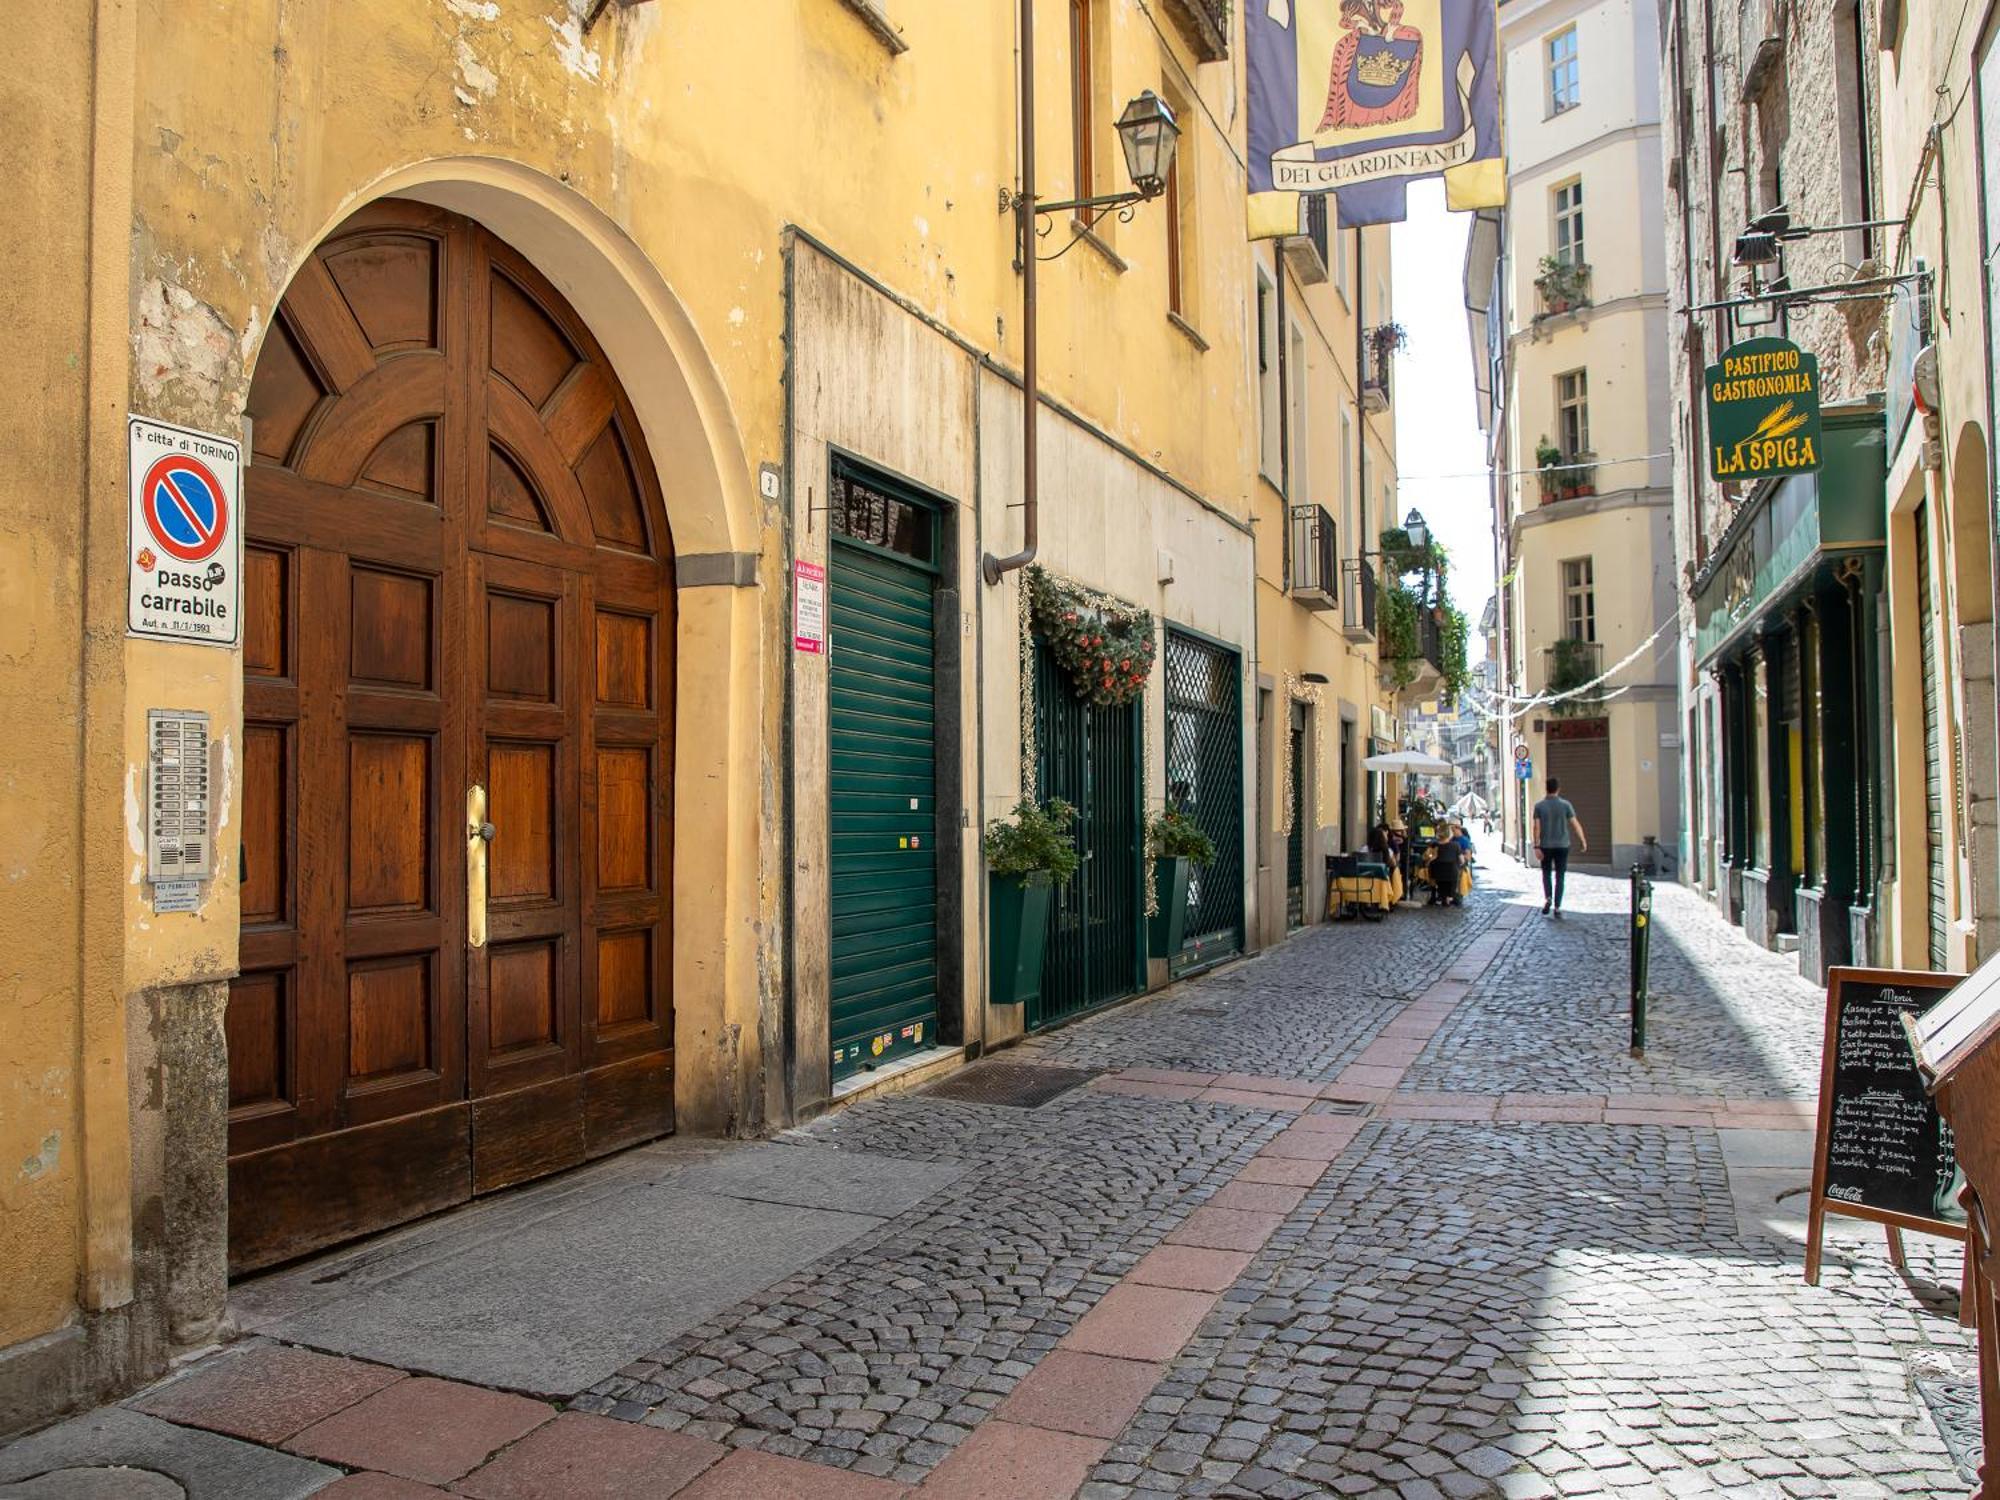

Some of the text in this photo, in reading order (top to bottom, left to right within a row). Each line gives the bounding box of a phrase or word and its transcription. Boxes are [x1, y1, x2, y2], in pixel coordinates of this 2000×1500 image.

[1280, 142, 1467, 184] DEI GUARDINFANTI
[1724, 350, 1799, 377] PASTIFICIO
[1713, 373, 1812, 402] GASTRONOMIA
[179, 439, 189, 451] di
[193, 442, 234, 461] TORINO
[1715, 436, 1816, 474] LA SPIGA
[157, 569, 213, 592] passo
[140, 594, 227, 619] carrabile
